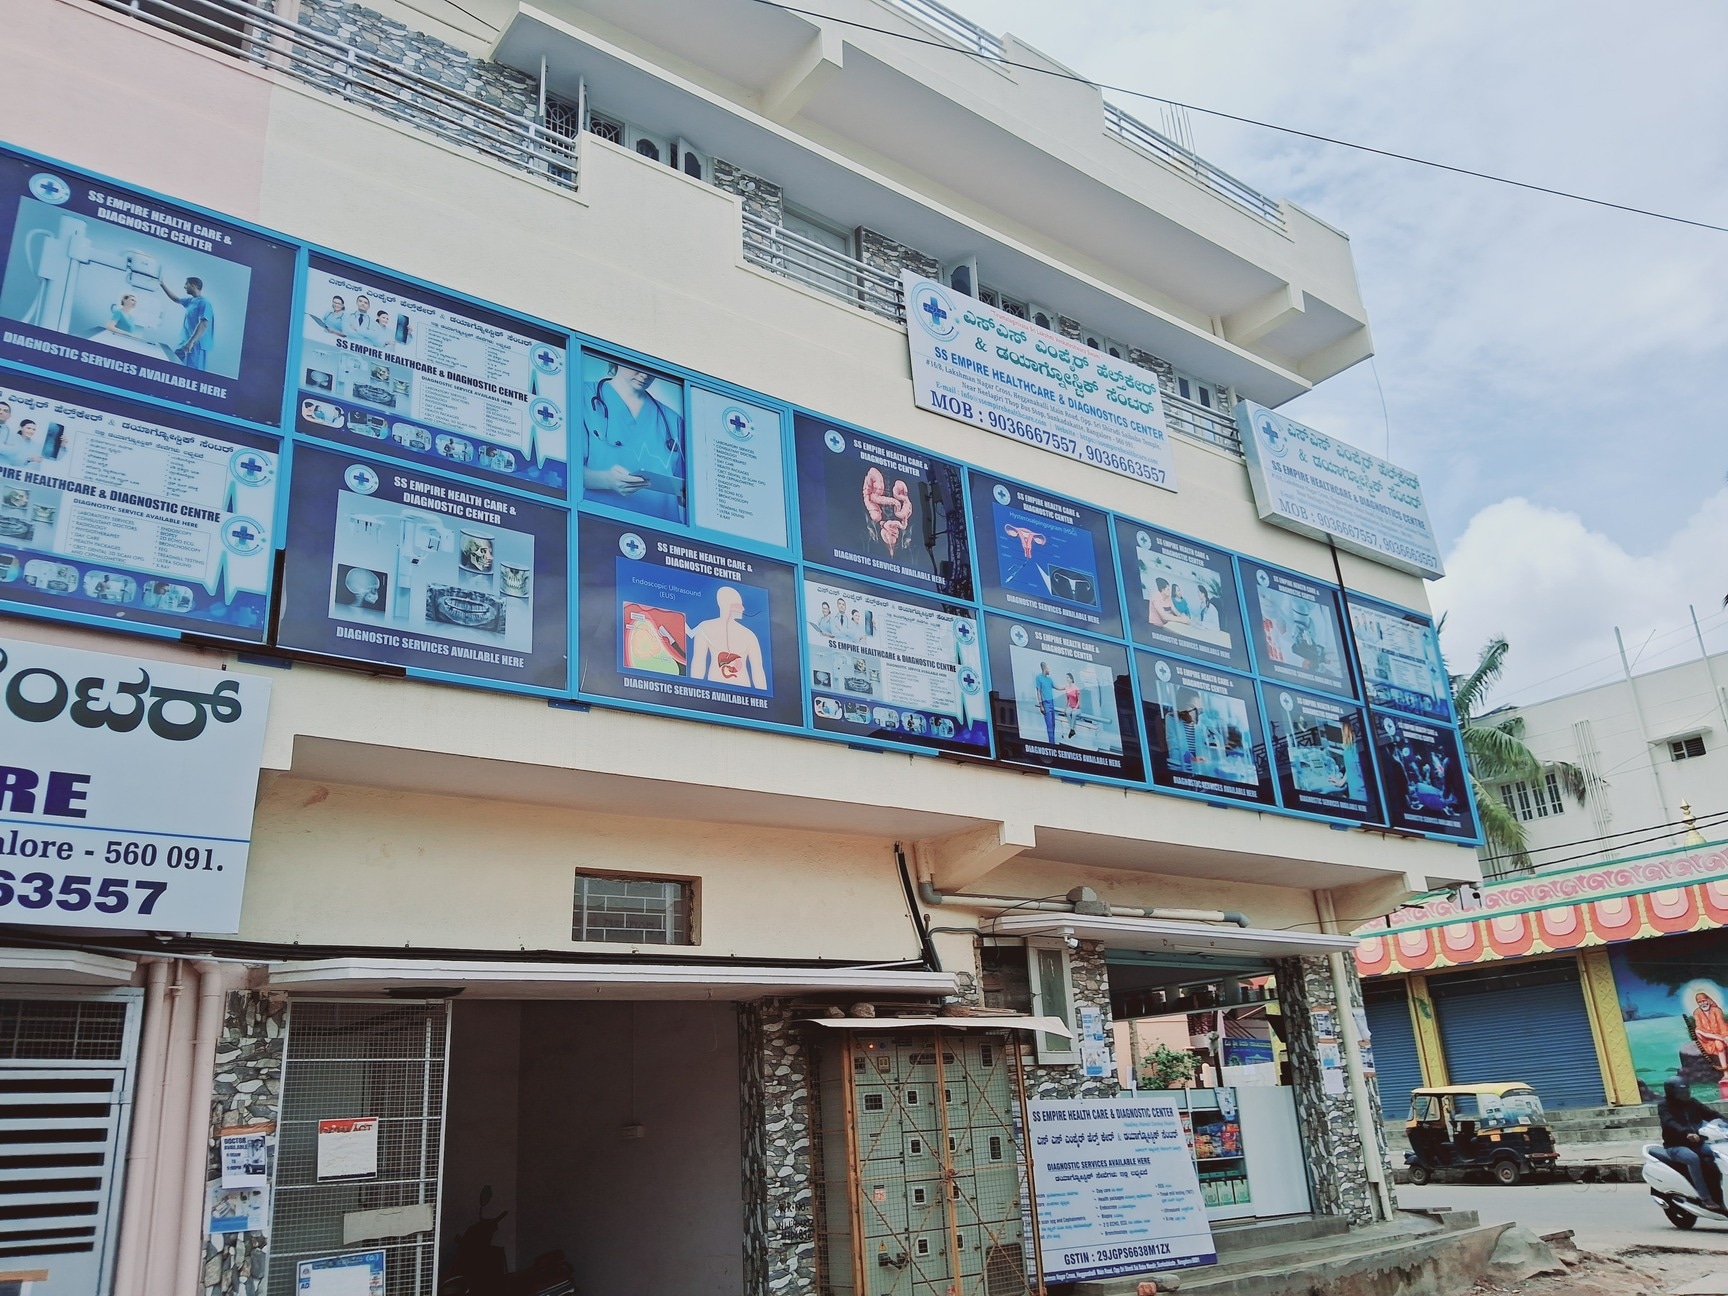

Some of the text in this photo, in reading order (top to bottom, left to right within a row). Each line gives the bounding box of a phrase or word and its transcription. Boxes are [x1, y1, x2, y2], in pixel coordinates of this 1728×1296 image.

[88, 190, 232, 245] SS EMPIRE HEALTH CARE &
[97, 206, 212, 252] DIAGNOSTIC CENTER
[3, 331, 228, 399] DIAGNOSTIC SERVICES AVAILABLE HERE
[336, 339, 528, 402] SS EMPIRE HEALTHCARE & DIAGNOSTIC CENTRE
[945, 366, 975, 382] Lakshman
[977, 378, 993, 390] Nagar
[975, 337, 987, 352] &
[1106, 388, 1154, 415] ಸೆಂಟರ್
[421, 376, 499, 402] DIAGNOSTIC SERVICE AVAILABLE
[935, 346, 1164, 441] SS EMPIRE HEALTHCARE & DIAGNOSTICS CENTER
[962, 382, 976, 392] Near
[108, 418, 115, 427] &
[930, 390, 973, 419] MOB
[1086, 445, 1166, 483] 9036663557
[853, 439, 862, 448] SS
[863, 442, 886, 456] EMPIRE
[886, 448, 907, 463] HEALTH
[908, 456, 923, 468] CARE
[860, 451, 920, 476] DIAGNOSTIC CENTER
[394, 476, 516, 515] SS EMPIRE HEALTH CARE &
[1272, 460, 1282, 471] SS
[1284, 465, 1310, 483] EMPIRE
[1311, 476, 1351, 501] HEALTHCARE
[25, 472, 221, 523] HEALTHCARE & DIAGNOSTIC CENTRE
[73, 498, 116, 511] DIAGNOSTIC
[118, 508, 144, 517] SERVICE
[146, 513, 180, 524] AVAILABLE
[403, 493, 501, 524] DIAGNOSTIC CENTER
[1279, 497, 1308, 520] MOB
[657, 542, 668, 552] SS
[670, 545, 698, 560] EMPIRE
[699, 552, 725, 565] HEALTH
[727, 559, 746, 570] CARE
[665, 556, 741, 581] DIAGNOSTIC CENTER
[632, 576, 702, 597] Endoscopic Ultrasound
[659, 591, 676, 600] (EUS)
[336, 626, 524, 668] DIAGNOSTIC SERVICES AVAILABLE HERE
[828, 640, 956, 673] SS EMPIRE HEALTHCARE DIAGNOSTIC CENTRE
[623, 677, 768, 709] DIAGNOSTIC SERVICES AVAILABLE HERE
[104, 840, 157, 867] 560
[167, 845, 224, 872] 091.
[1032, 1111, 1041, 1122] SS
[1043, 1110, 1067, 1122] EMPIRE
[1068, 1109, 1091, 1120] HEALTH
[1092, 1109, 1109, 1119] CARE
[1117, 1108, 1151, 1119] DIAGNOSTIC
[1151, 1107, 1174, 1118] CENTER
[1047, 1157, 1151, 1171] DIAGNOSTIC SERVICES AVAILABLE HERE
[1064, 1243, 1171, 1265] GSTIN 29JGPS6638M1ZX
